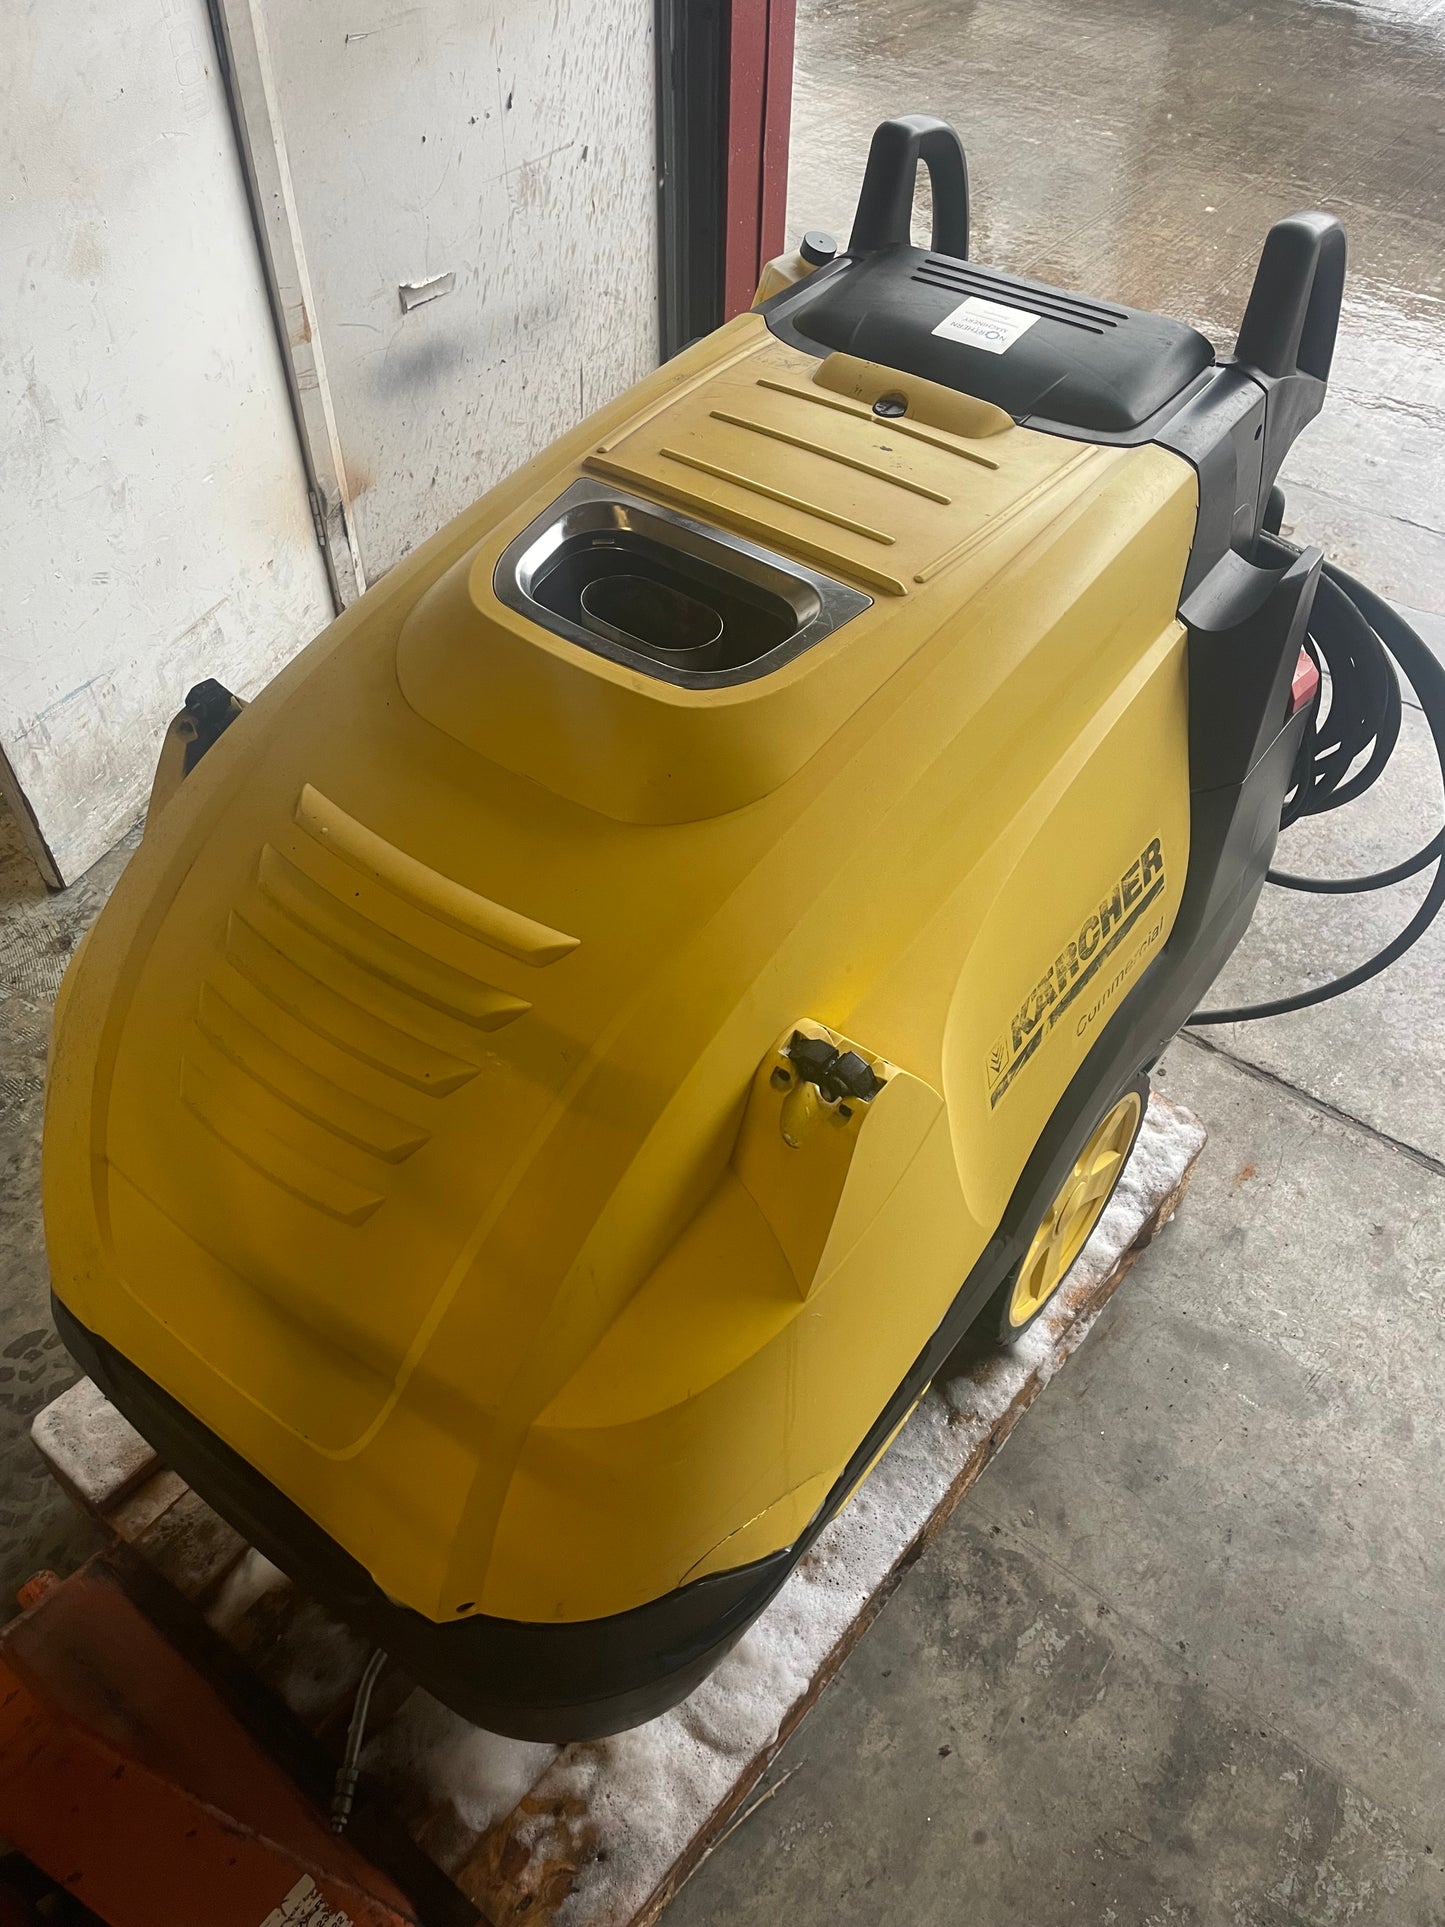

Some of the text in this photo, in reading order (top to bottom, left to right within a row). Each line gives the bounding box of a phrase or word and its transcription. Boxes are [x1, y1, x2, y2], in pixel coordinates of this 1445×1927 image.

[950, 321, 1007, 342] NORTHERN
[963, 317, 1008, 333] MACHINERY
[1010, 837, 1164, 1053] KÄRCHER
